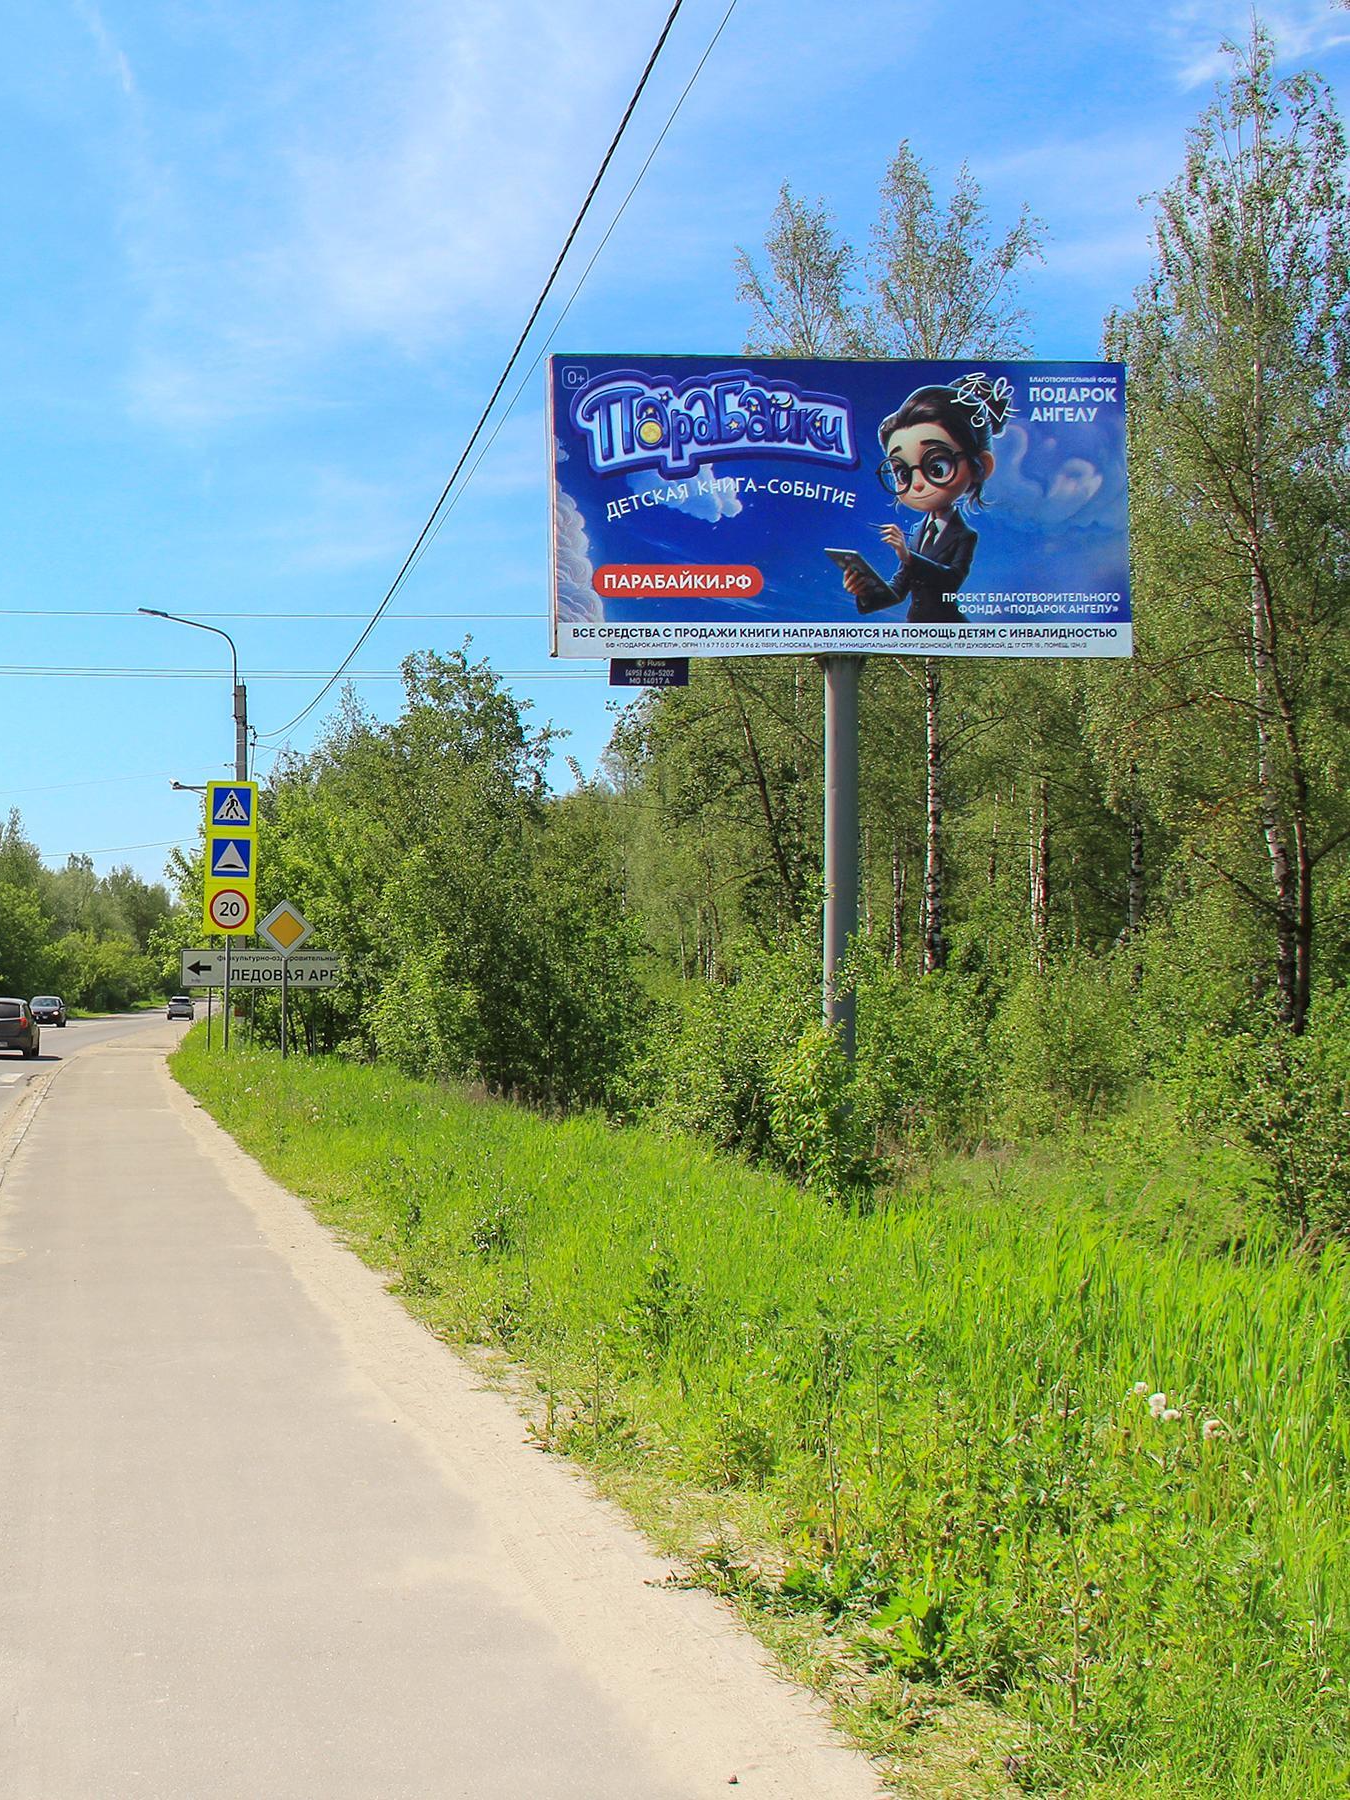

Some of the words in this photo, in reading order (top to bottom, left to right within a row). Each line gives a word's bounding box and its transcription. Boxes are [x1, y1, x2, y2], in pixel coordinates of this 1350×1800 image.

[567, 371, 585, 384] 0+
[1097, 376, 1117, 384] ФОНД
[1028, 387, 1117, 404] ПОДАРОК
[1030, 407, 1098, 422] АНГЕЛУ
[606, 484, 689, 522] ДЕТСКАЯ
[697, 477, 857, 509] КНИГА-СОБЫТИЕ
[603, 570, 752, 590] ПАРАБАЙКИ.РФ
[942, 592, 986, 603] ПРОЕКТ
[988, 592, 1121, 603] БЛАГОТВОРИТЕЛЬНОГО
[958, 604, 1002, 615] ФОНДА
[1004, 604, 1066, 615] «ПОДАРОК
[1068, 604, 1119, 615] АНГЕЛУ»
[572, 628, 595, 638] ВСЕ
[598, 628, 661, 640] СРЕДСТВА
[663, 628, 672, 638] С
[674, 628, 737, 640] ПРОДАЖИ
[740, 628, 779, 638] КНИГИ
[782, 628, 879, 638] НАПРАВЛЯЮТСЯ
[882, 628, 899, 638] НА
[902, 628, 956, 640] ПОМОЩЬ
[958, 628, 996, 640] ДЕТЯМ
[998, 628, 1007, 638] С
[1010, 628, 1117, 640] ИНВАЛИДНОСТЬЮ
[219, 901, 240, 917] 20
[231, 969, 304, 983] ЛЕДОВАЯ
